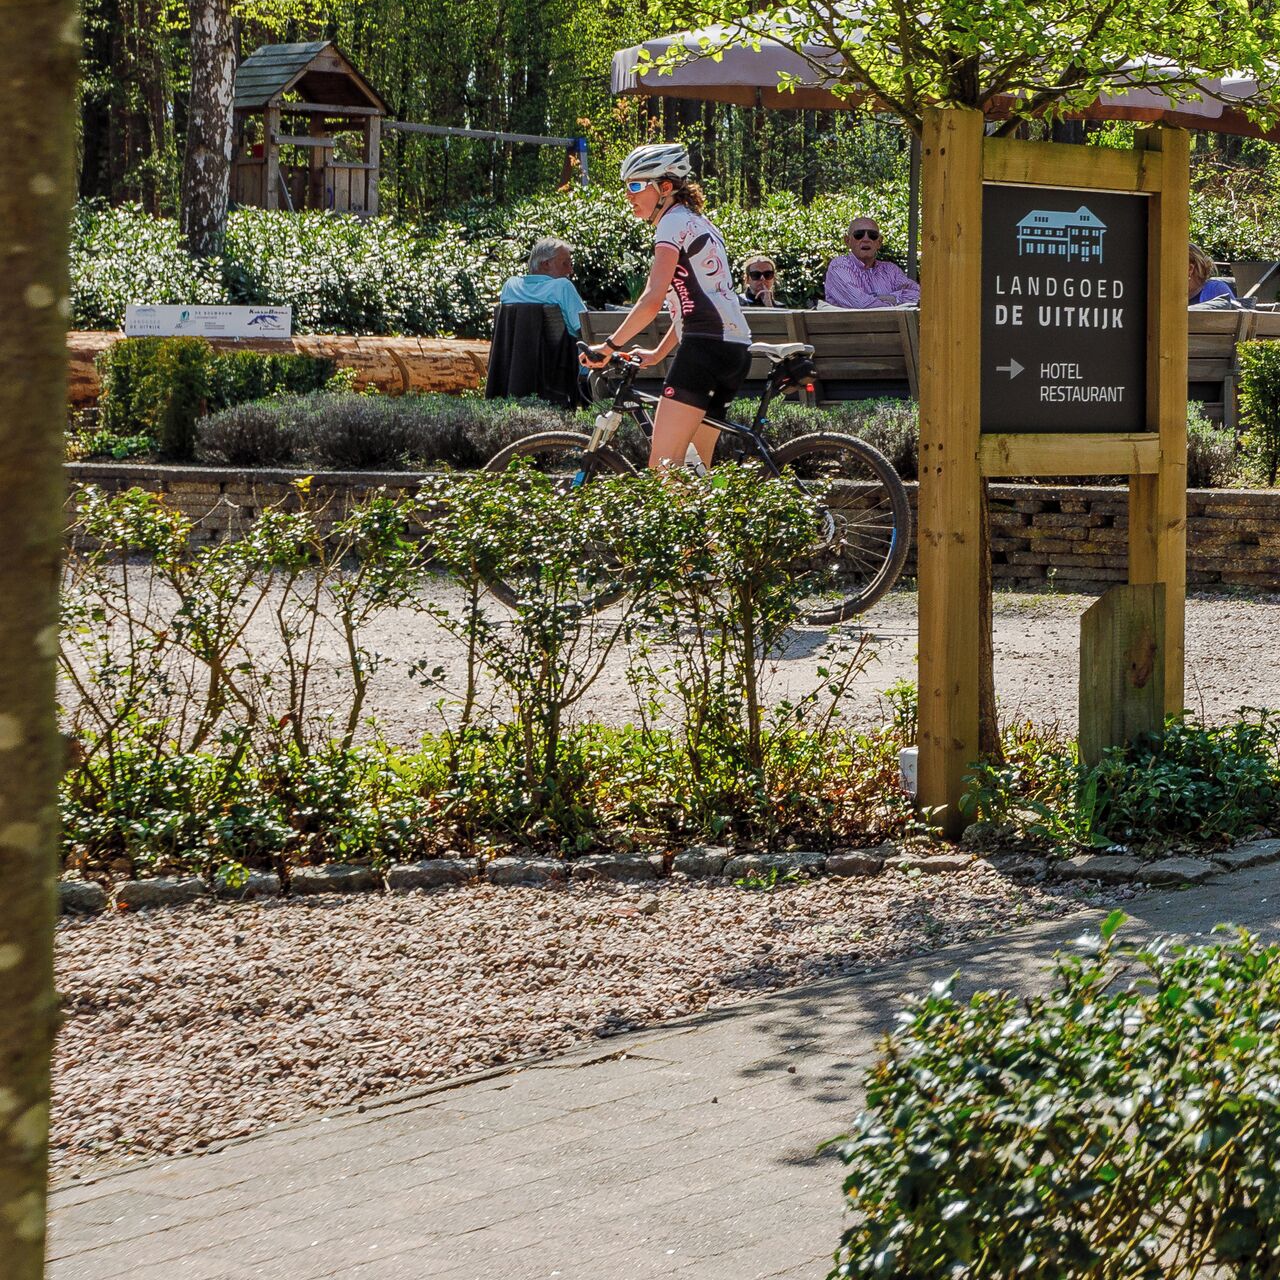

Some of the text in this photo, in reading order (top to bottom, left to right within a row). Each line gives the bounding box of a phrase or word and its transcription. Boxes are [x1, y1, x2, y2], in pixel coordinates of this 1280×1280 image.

[996, 275, 1124, 299] LANDGOED
[995, 304, 1124, 330] DE UITKIJK
[1040, 362, 1084, 380] HOTEL
[1040, 385, 1126, 403] RESTAURANT
